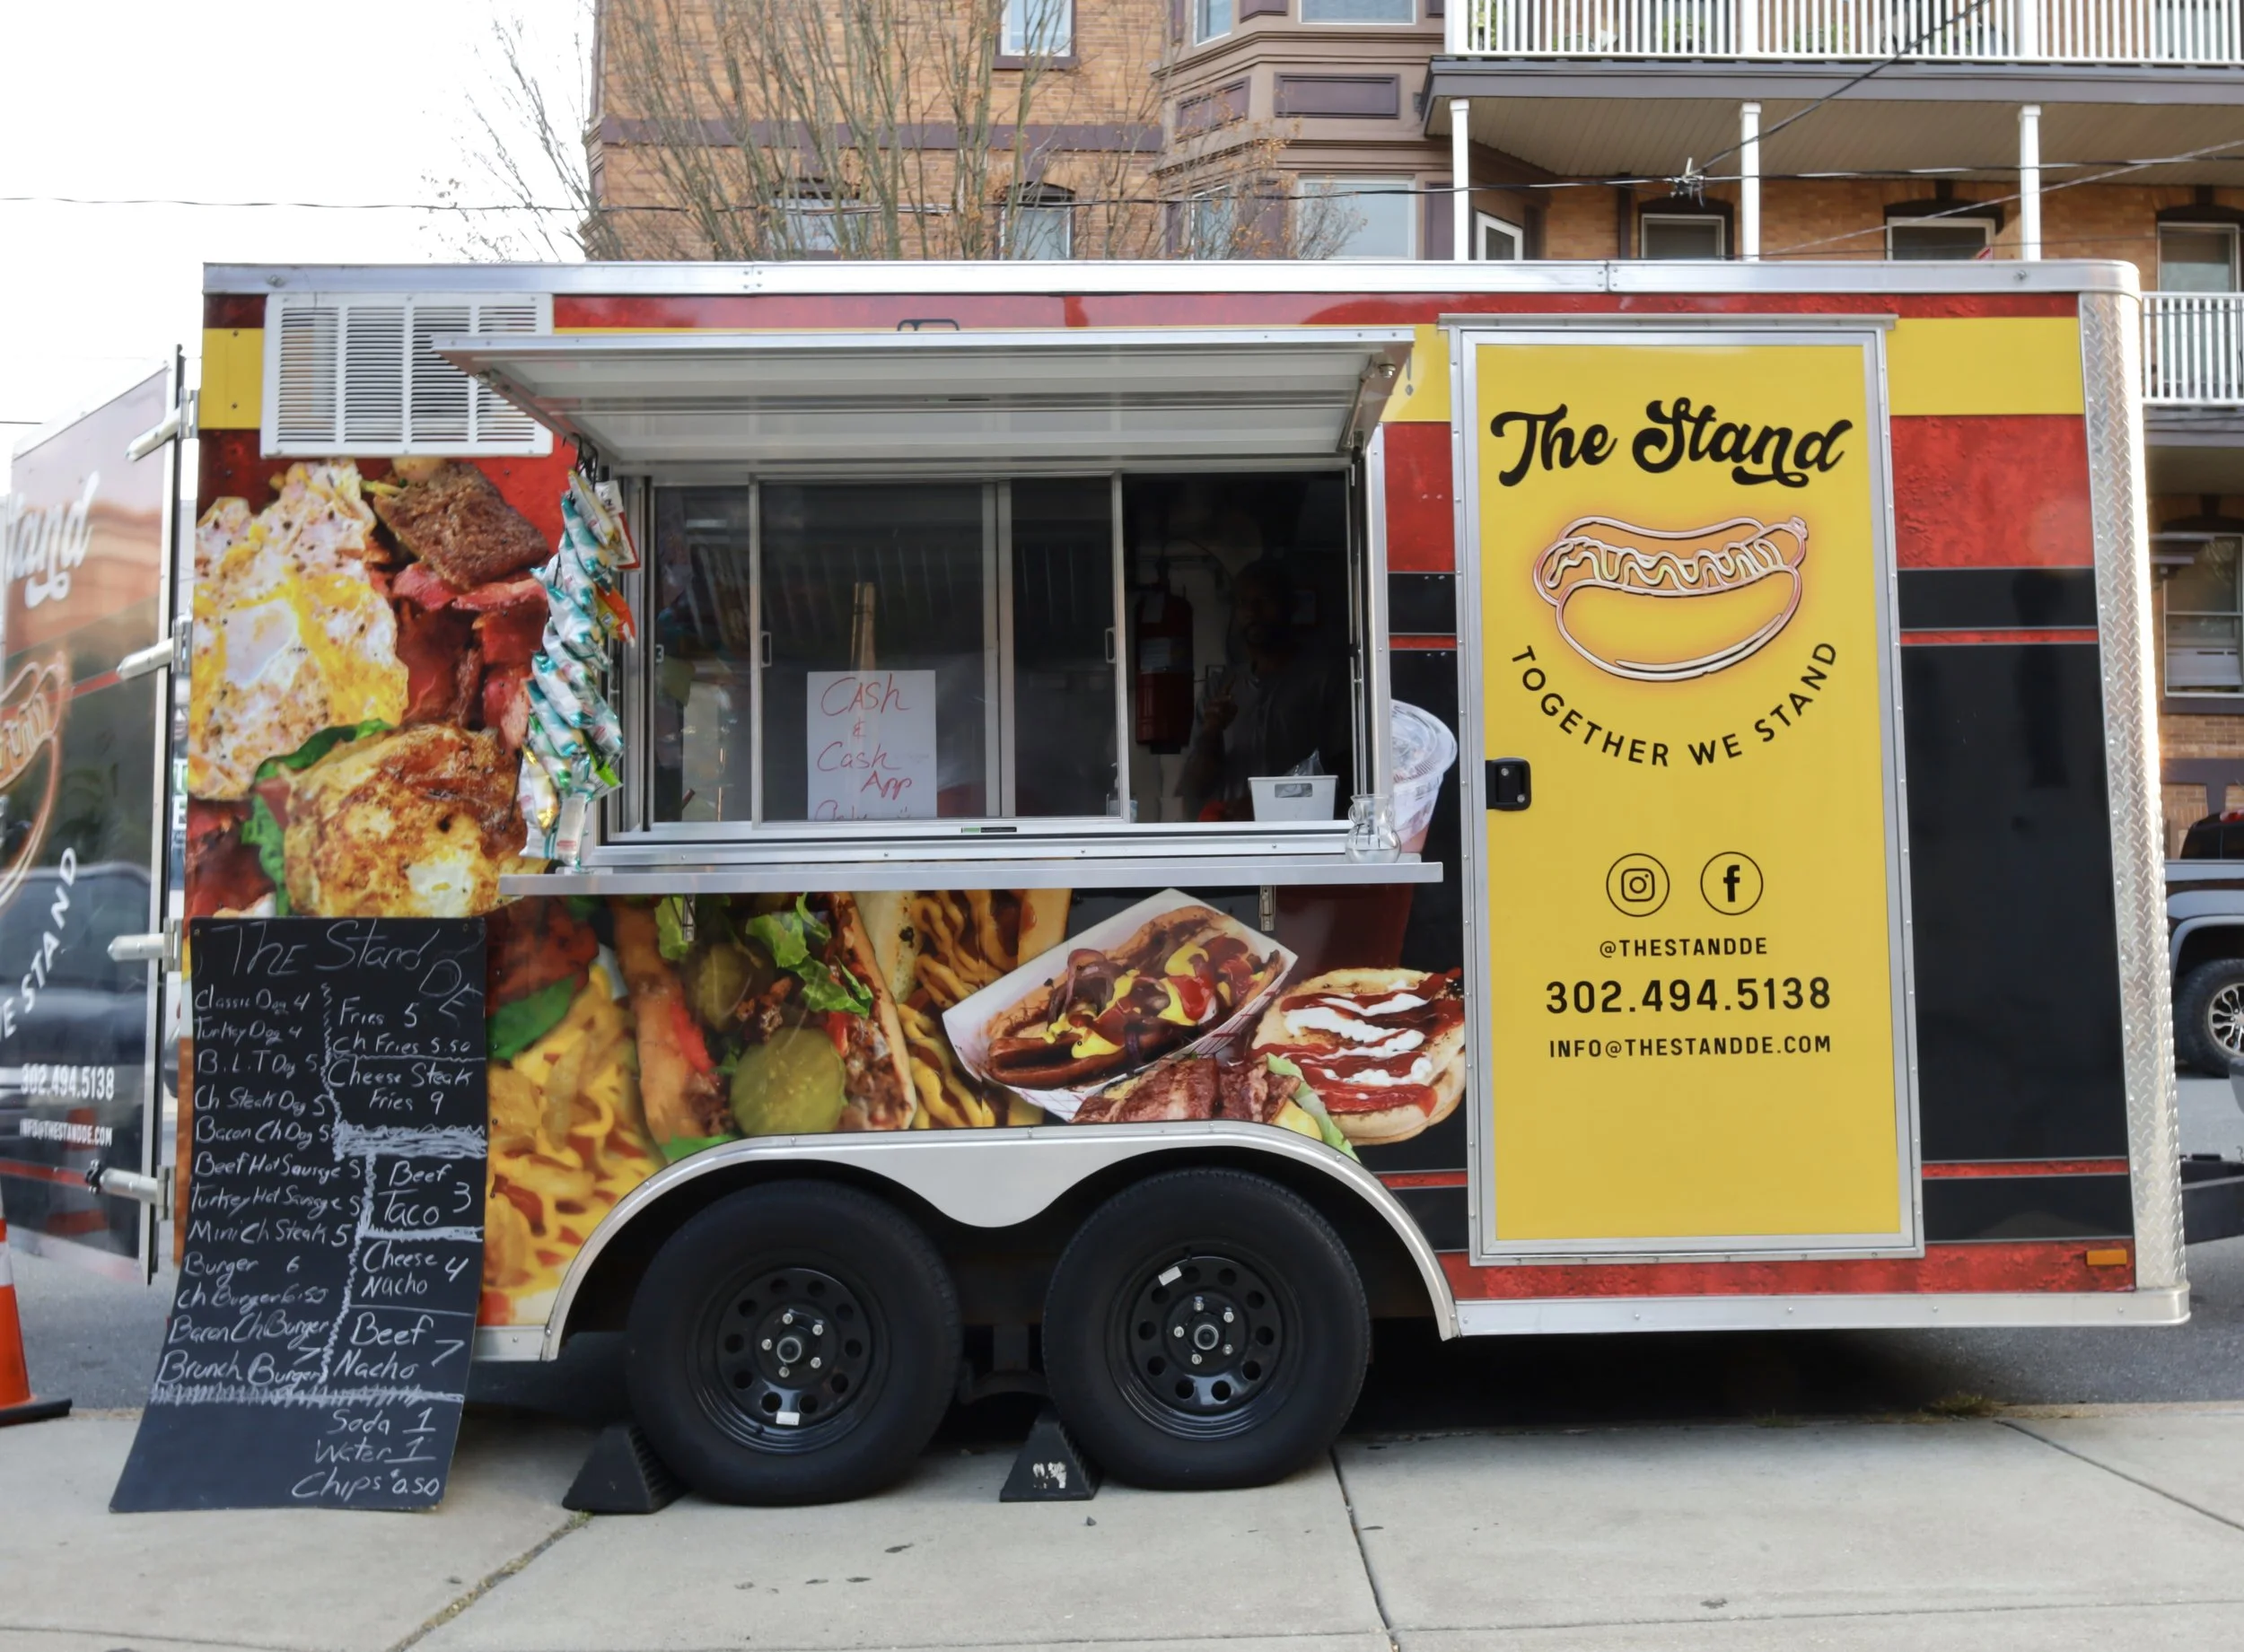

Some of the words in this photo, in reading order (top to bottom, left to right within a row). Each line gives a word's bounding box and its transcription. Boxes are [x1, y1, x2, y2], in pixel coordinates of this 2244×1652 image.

[1490, 404, 1617, 486] The
[1632, 397, 1853, 488] Stand
[5, 469, 99, 608] tand
[1512, 645, 1669, 768] TOGETHER
[1687, 733, 1742, 767] WE
[1754, 642, 1836, 743] STAND
[817, 741, 902, 772] Cash
[860, 770, 913, 800] App
[21, 847, 77, 1014] STAND
[314, 918, 440, 970] Stand
[1599, 937, 1768, 958] @THESTANDDE
[294, 992, 310, 1011] 4
[1546, 976, 1831, 1014] 302.494.5138
[339, 996, 385, 1027] Fries
[404, 1002, 419, 1027] 5
[288, 1027, 302, 1039] 4
[375, 1032, 419, 1054] Fries
[1549, 1036, 1831, 1058] INFO@THESTANDDE.COM
[305, 1053, 319, 1071] 5
[328, 1056, 401, 1088] Cheese
[21, 1063, 114, 1101] 302.494.5138
[312, 1094, 329, 1116] 5
[369, 1087, 413, 1112] Fries
[430, 1091, 444, 1115] 9
[319, 1123, 330, 1142] 5
[195, 1150, 251, 1177] Beef
[348, 1159, 361, 1178] 5
[389, 1160, 452, 1186] Beef
[349, 1195, 361, 1217] 5
[378, 1189, 440, 1228] Taco
[452, 1182, 472, 1212] 3
[331, 1224, 353, 1246] 5
[185, 1251, 259, 1289] Burger
[286, 1255, 301, 1273] 6
[363, 1239, 438, 1272] Cheese
[445, 1256, 469, 1282] 4
[211, 1285, 281, 1315] Burger
[264, 1308, 329, 1350] Burger
[350, 1312, 434, 1345] Beef
[155, 1350, 243, 1385] Brunch
[248, 1352, 322, 1391] Burger
[333, 1349, 419, 1379] Nacho
[431, 1339, 465, 1368] 7
[327, 1409, 390, 1436] Soda
[402, 1407, 436, 1434] 1
[292, 1466, 381, 1502] Chips
